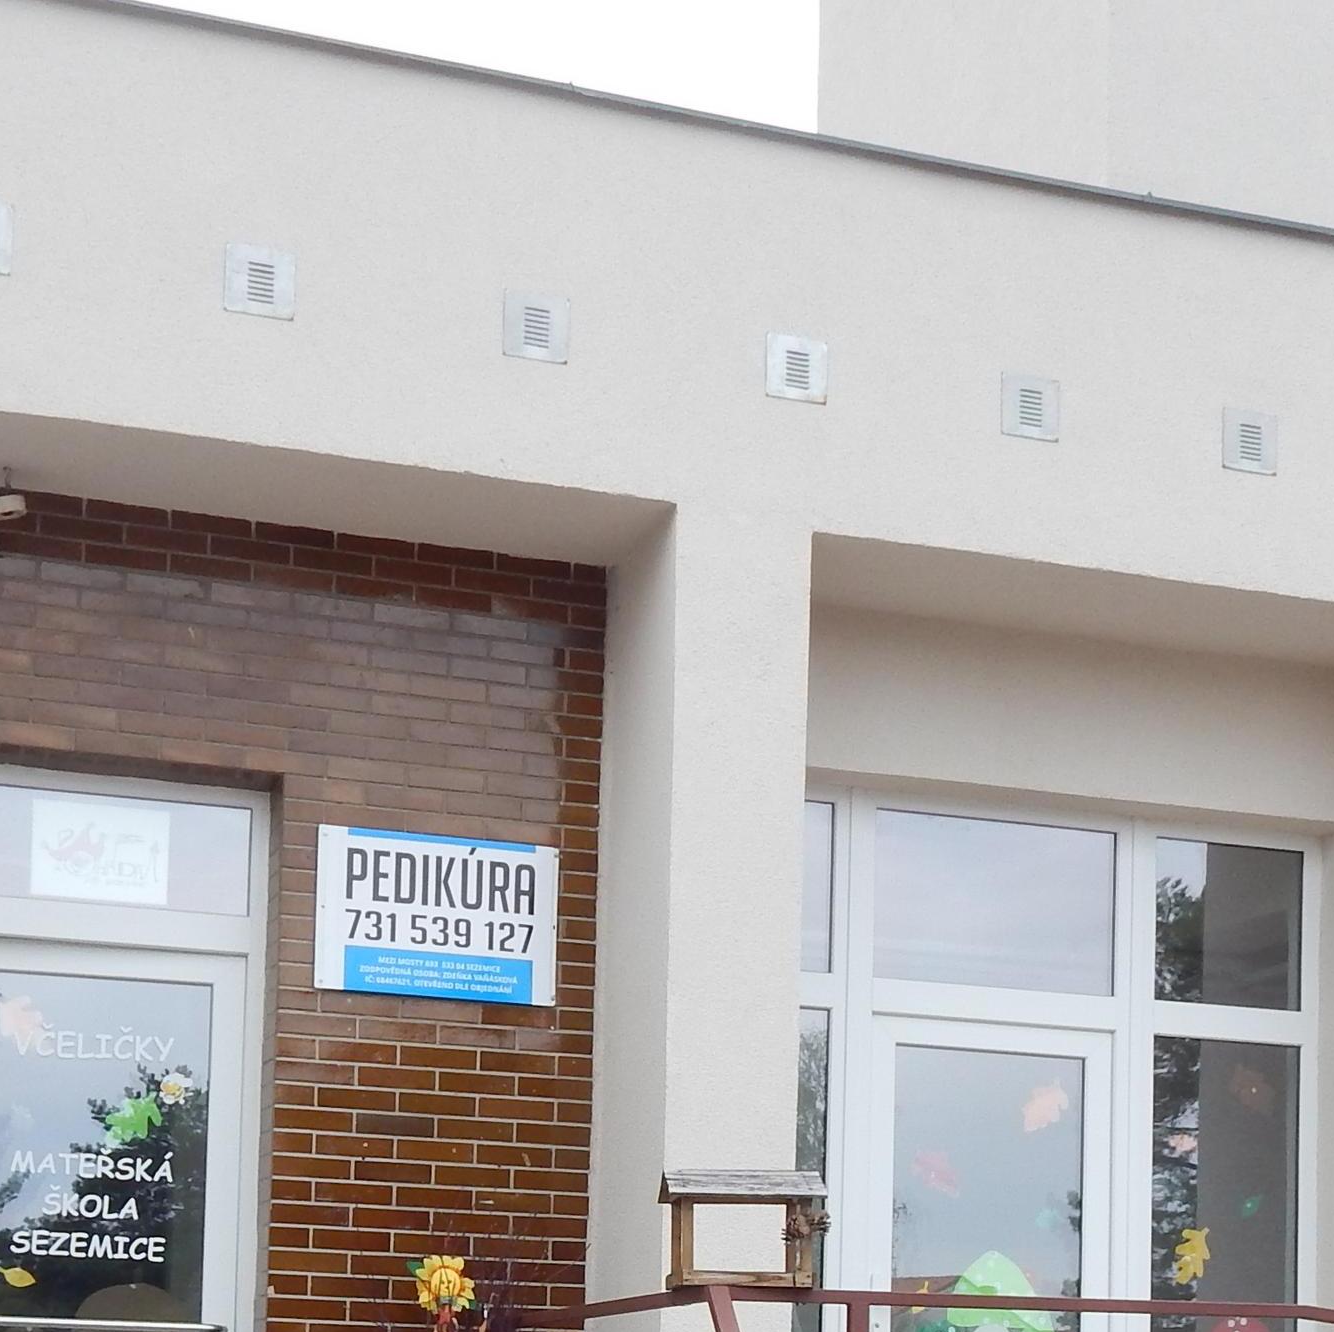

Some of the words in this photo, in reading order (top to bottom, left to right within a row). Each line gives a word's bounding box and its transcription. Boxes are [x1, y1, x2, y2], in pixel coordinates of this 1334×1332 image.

[345, 847, 536, 916] PEDIKÚRA
[345, 908, 397, 943] 731
[410, 914, 471, 948] 539
[484, 921, 534, 954] 127
[15, 1022, 175, 1062] VČELIČKY
[10, 1148, 174, 1183] MATEŘSKÁ
[41, 1184, 139, 1221] ŠKOLA
[9, 1228, 167, 1263] SEZEMICE
